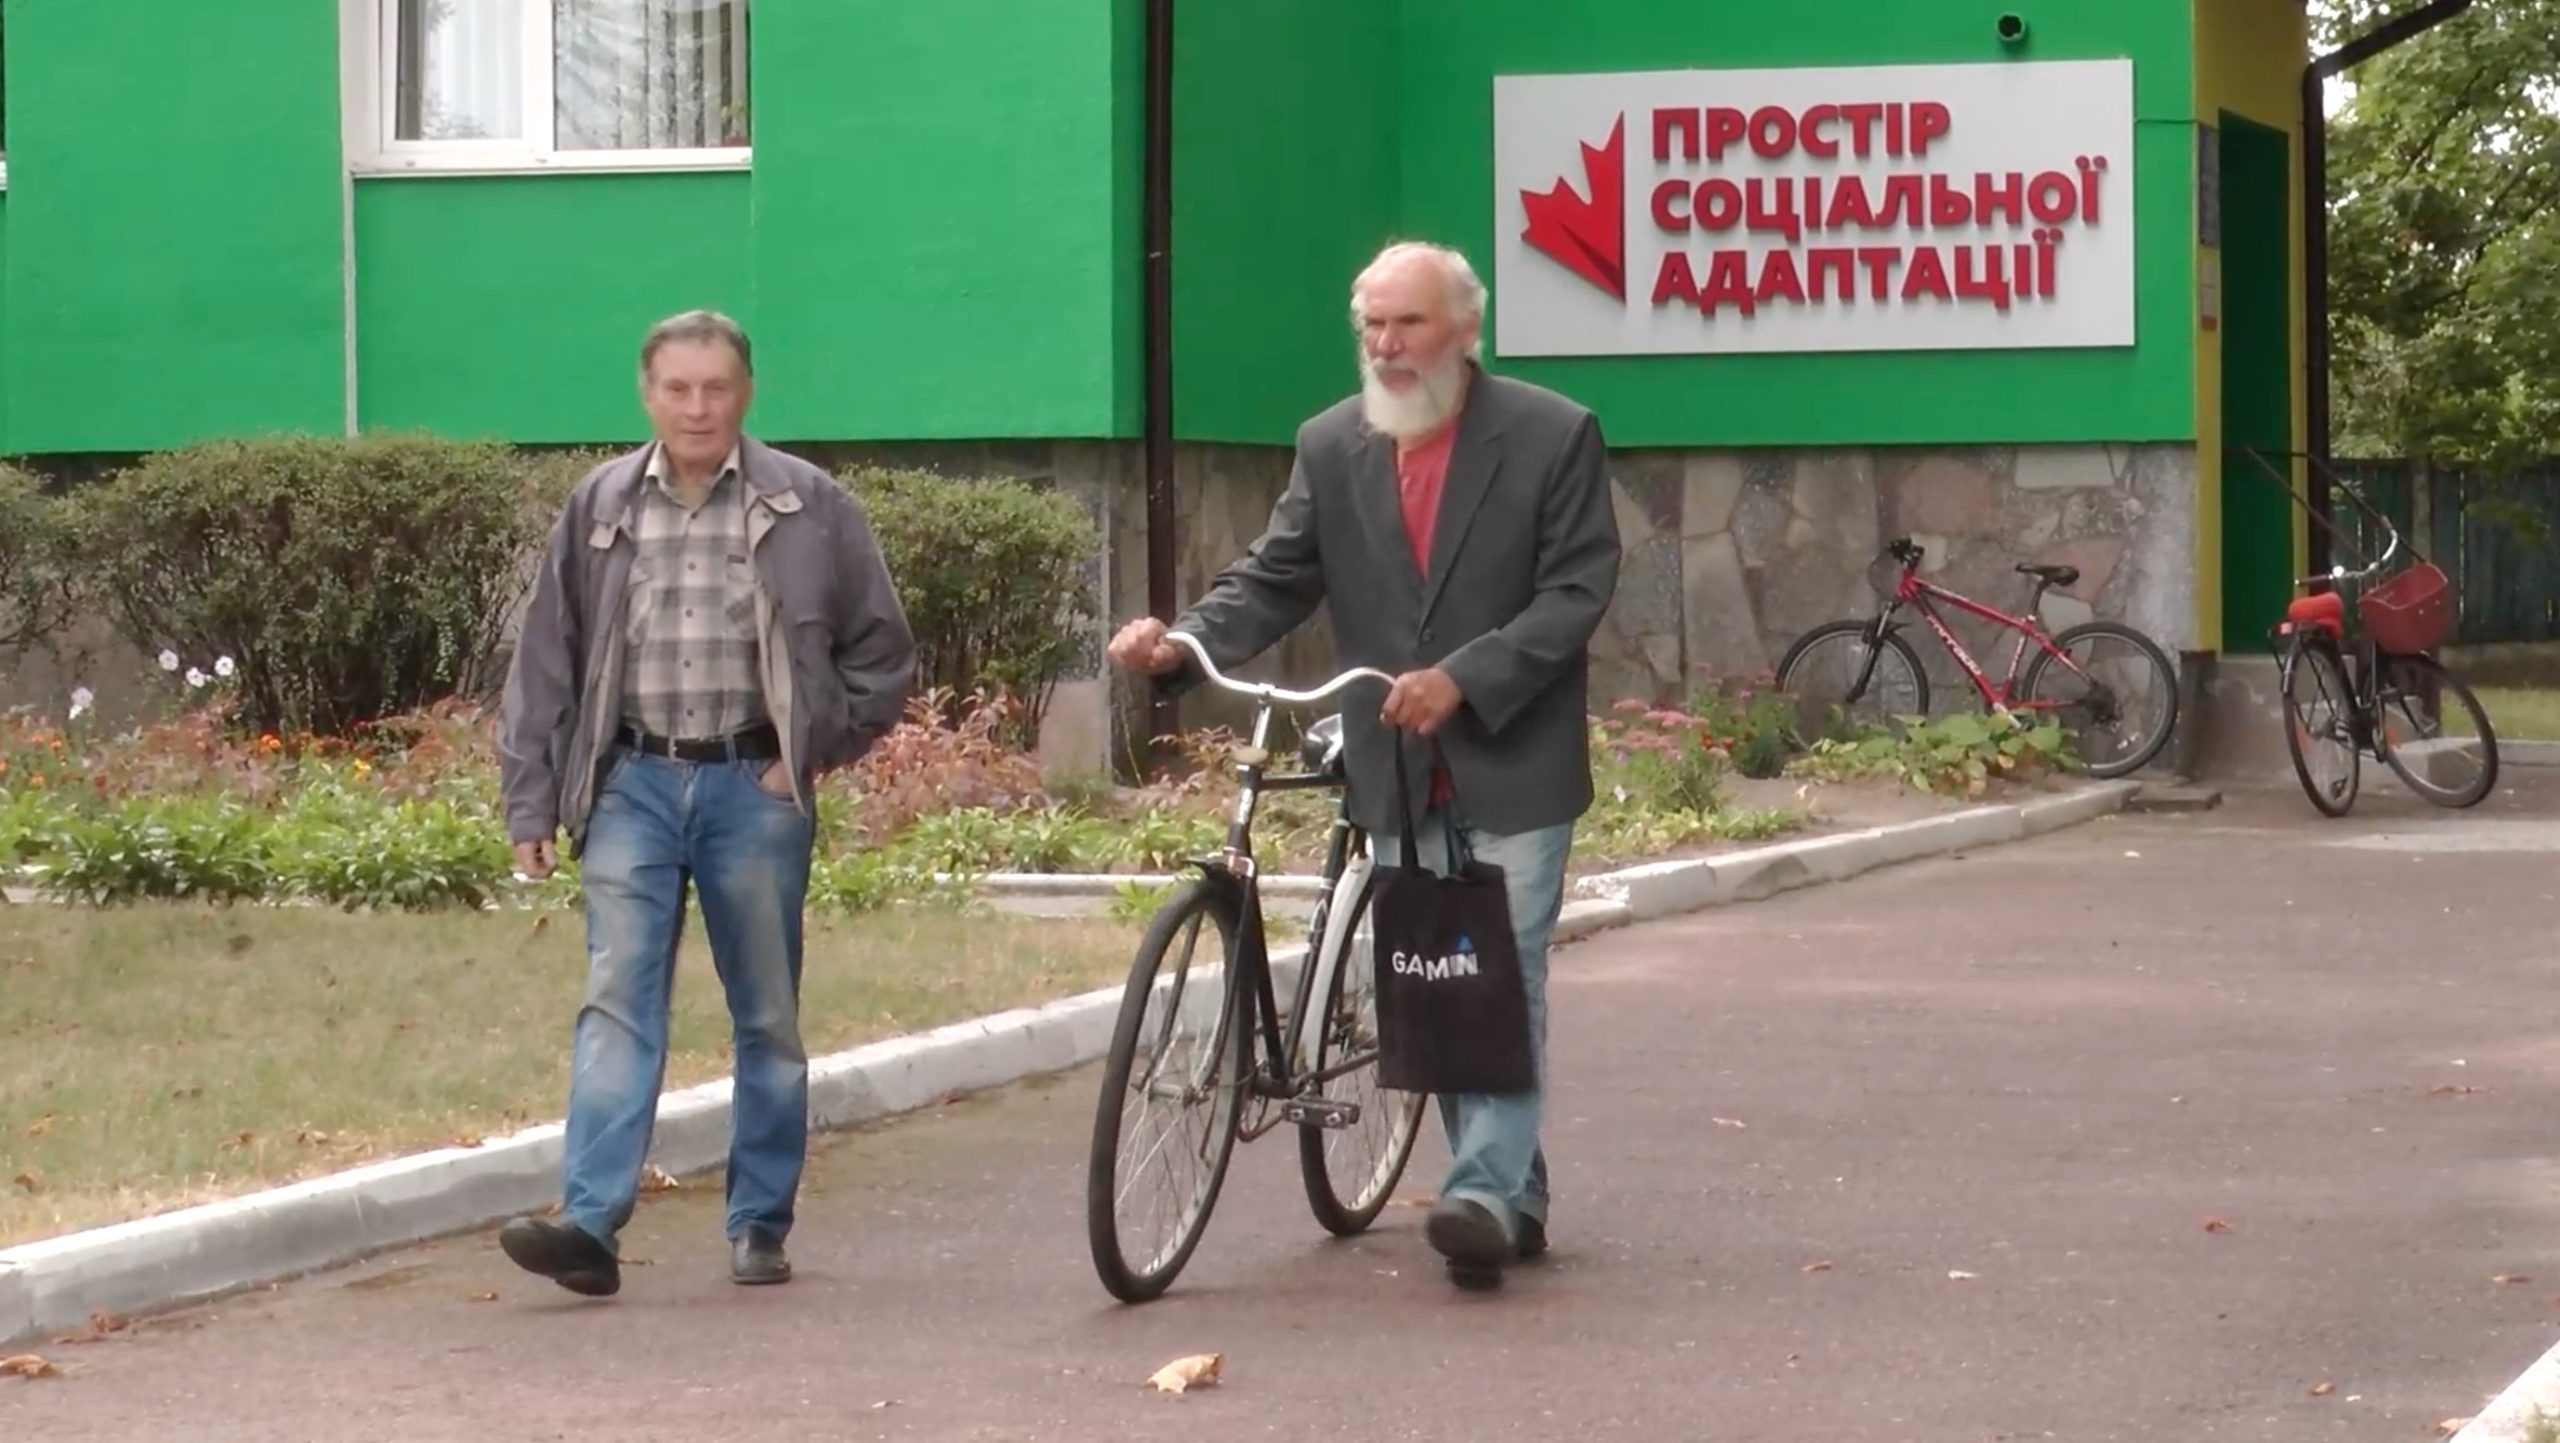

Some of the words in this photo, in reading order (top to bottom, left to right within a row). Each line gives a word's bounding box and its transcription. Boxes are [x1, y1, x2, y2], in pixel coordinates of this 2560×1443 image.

[1652, 102, 1950, 160] ПРОСТІР
[1651, 156, 2107, 242] СОЦІАЛЬНОЇ
[1652, 228, 2063, 316] АДАПТАЦІЇ
